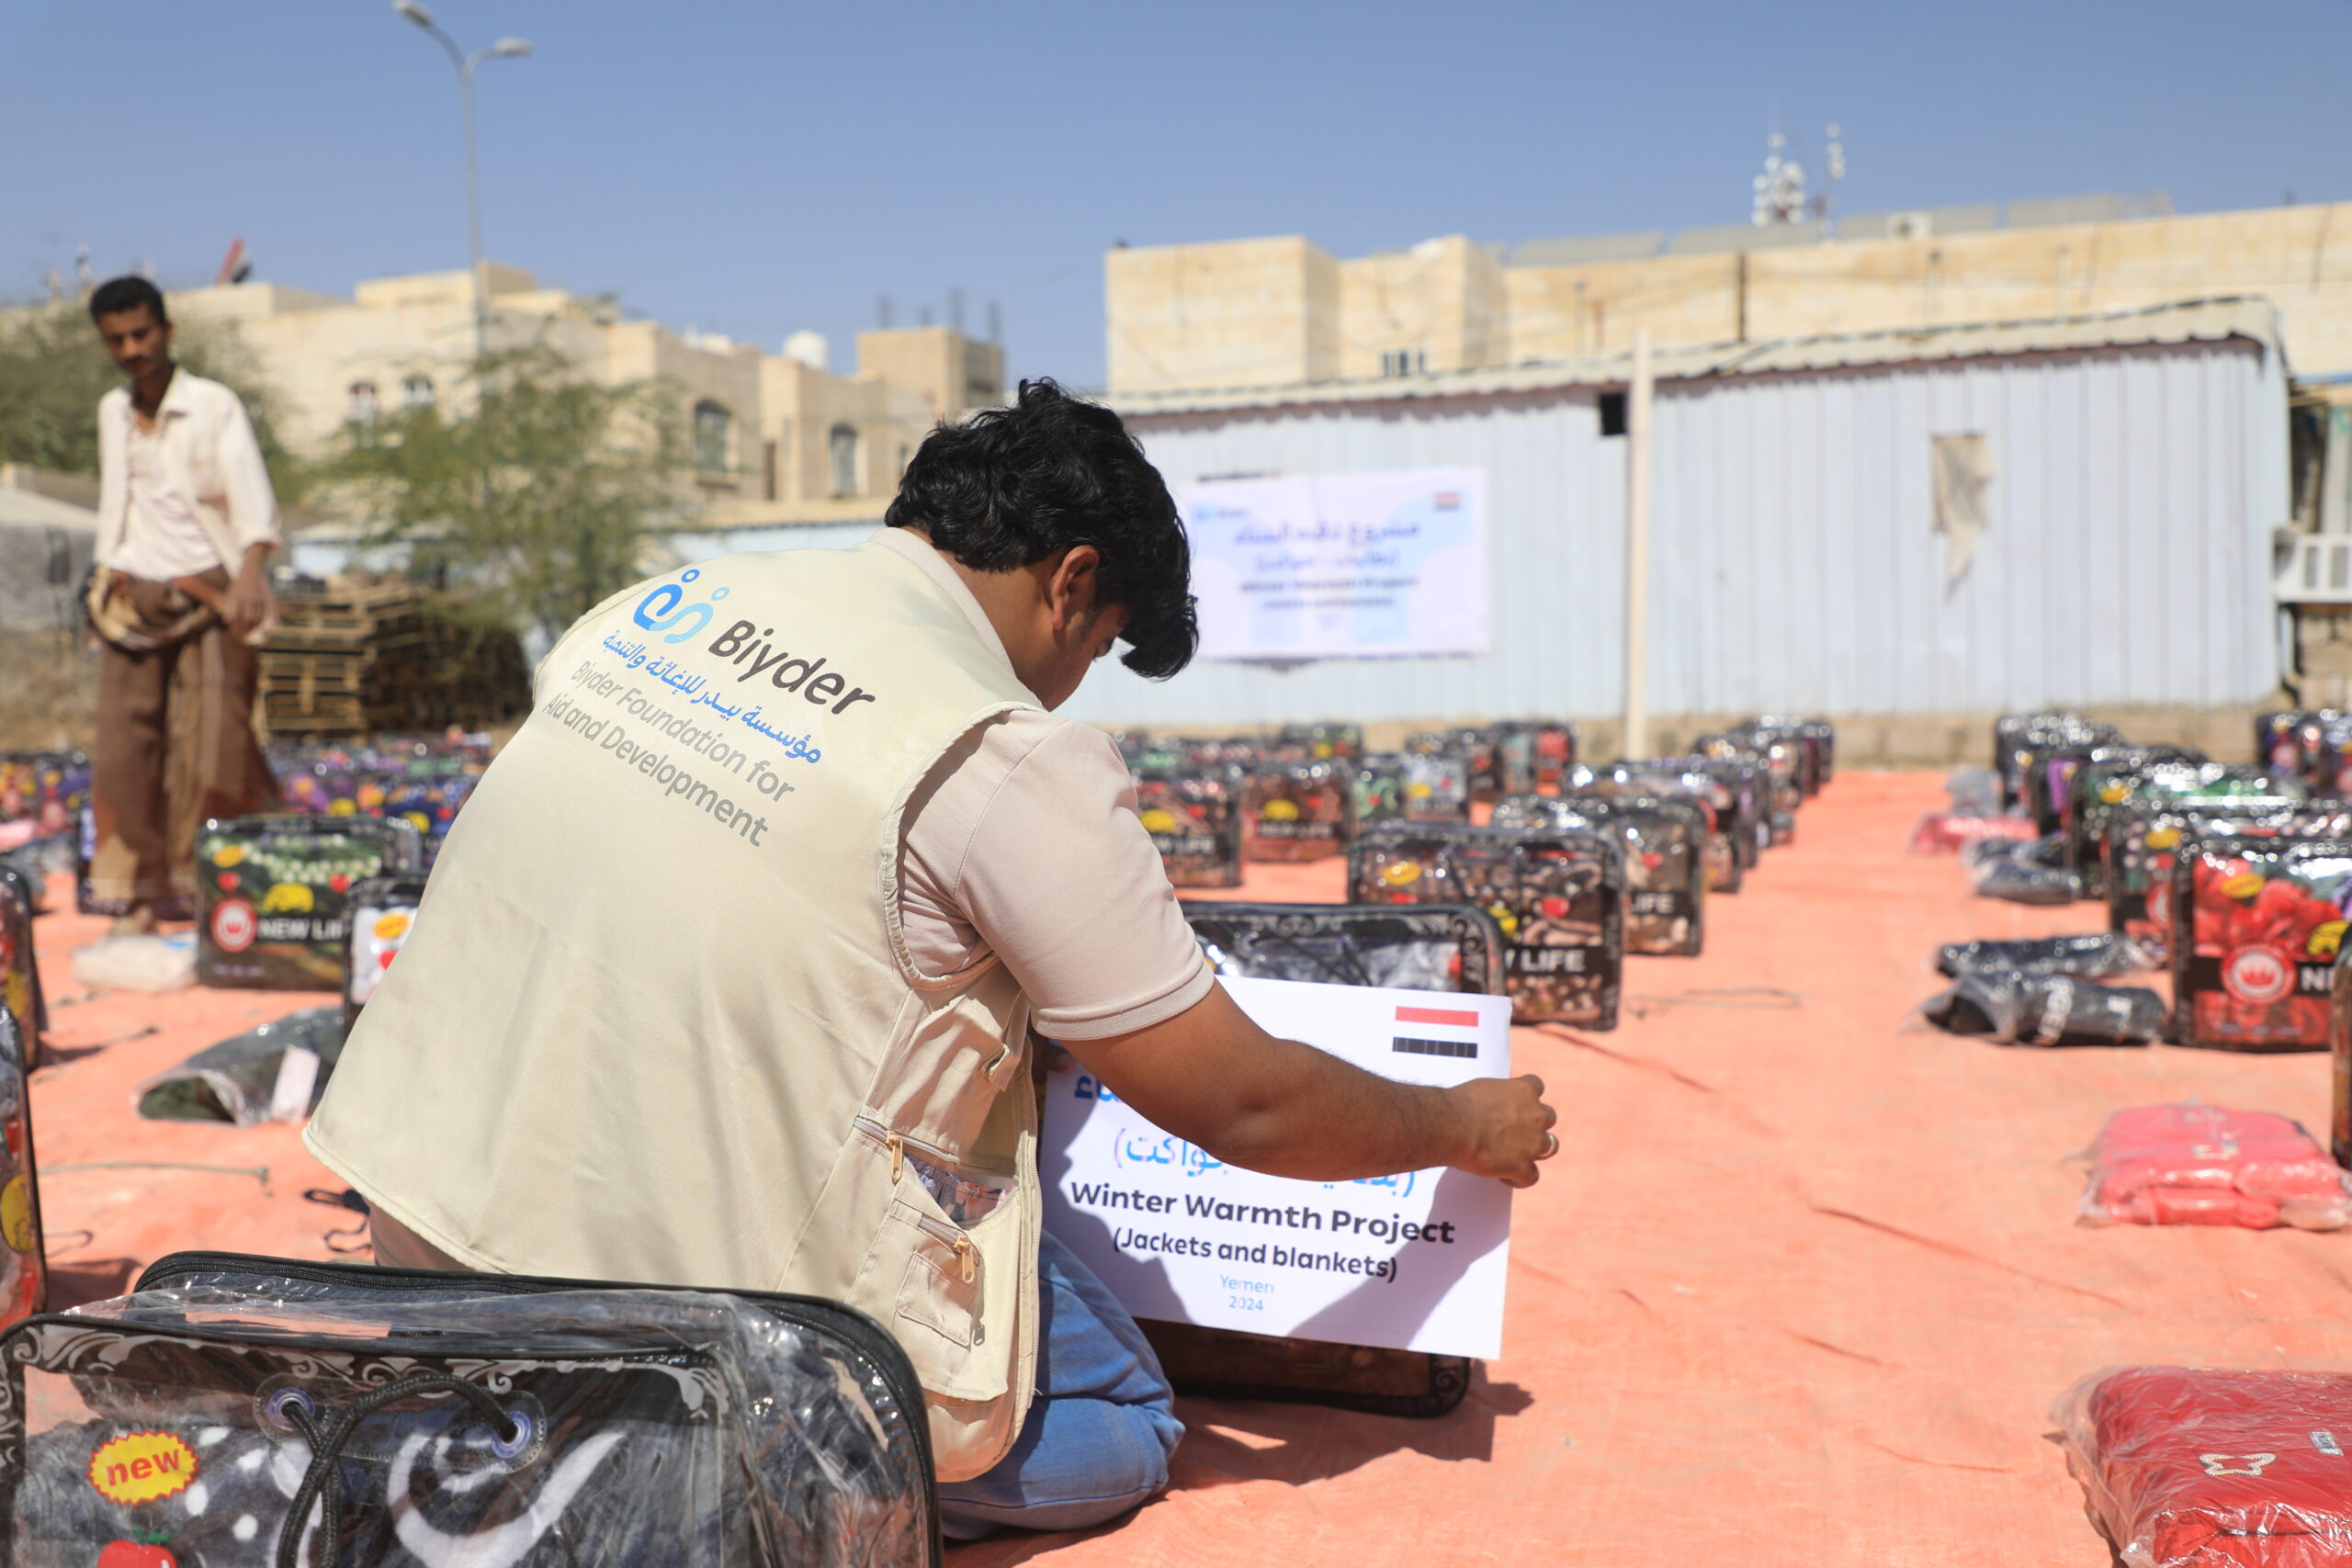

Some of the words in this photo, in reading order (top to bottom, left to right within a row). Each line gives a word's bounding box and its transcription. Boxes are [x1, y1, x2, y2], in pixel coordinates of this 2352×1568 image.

[603, 630, 647, 669] والتنمية
[707, 619, 876, 716] Biyder
[645, 655, 707, 694] للإغاثة
[690, 692, 741, 721] بيدر
[571, 660, 624, 700] Biyder
[616, 687, 747, 774] Foundation
[753, 760, 795, 802] for
[741, 705, 821, 763] مؤسسة
[543, 692, 566, 722] Aid
[563, 704, 610, 739] and
[600, 726, 769, 847] Development
[258, 918, 311, 939] NEW
[312, 919, 342, 939] LI
[1521, 950, 1586, 972] LIFE
[1070, 1181, 1178, 1215] Winter
[1185, 1193, 1322, 1231] Warmth
[1331, 1210, 1455, 1244] Project
[1114, 1227, 1212, 1259] (Jackets
[1217, 1232, 1266, 1262] and
[1272, 1245, 1397, 1282] blankets)
[1220, 1275, 1274, 1294] Yemen
[1228, 1295, 1264, 1312] 2024
[106, 1448, 182, 1488] new
